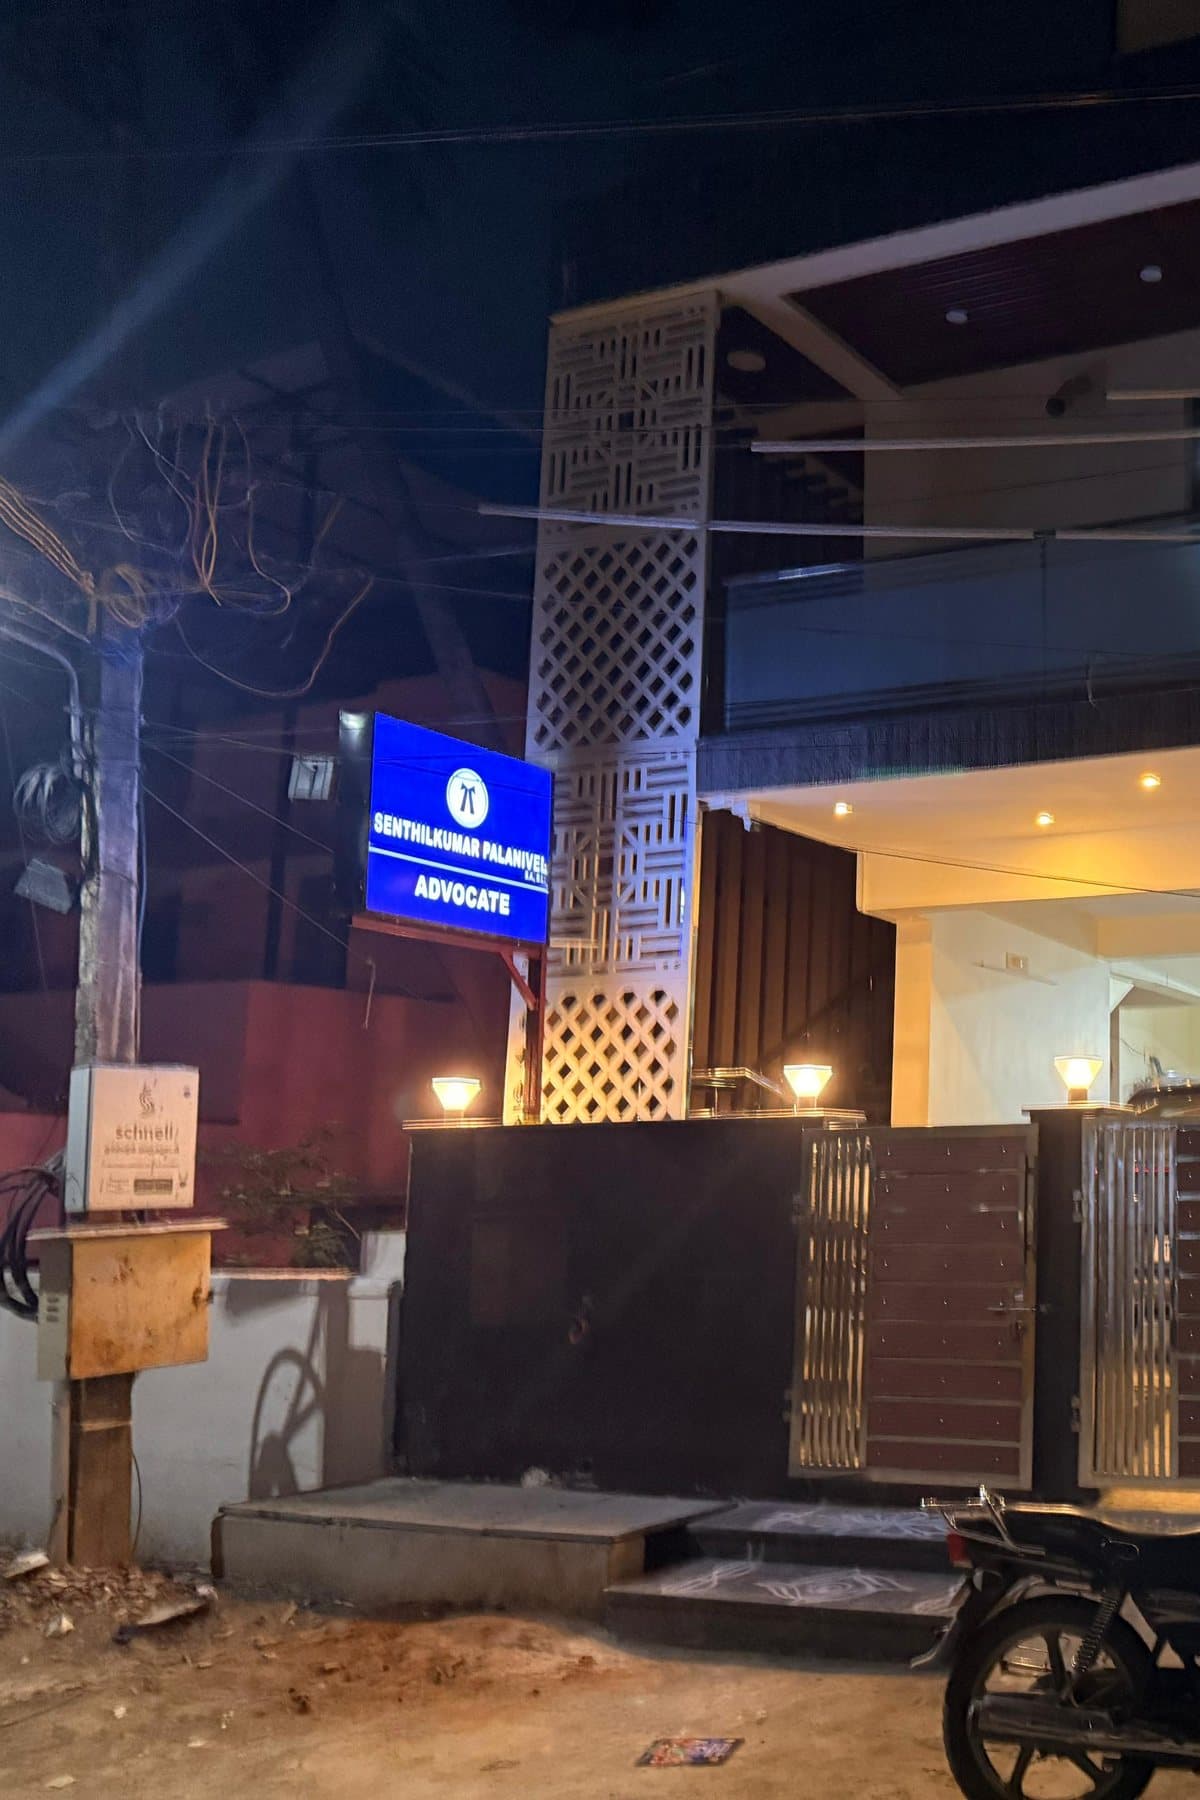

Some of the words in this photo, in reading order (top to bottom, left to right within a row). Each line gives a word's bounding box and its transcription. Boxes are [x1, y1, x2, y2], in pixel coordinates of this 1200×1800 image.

[374, 812, 480, 858] SENTHILKUMAR
[482, 840, 548, 874] PALANIVEL
[414, 875, 510, 916] ADVOCATE
[115, 1122, 173, 1141] schnell
